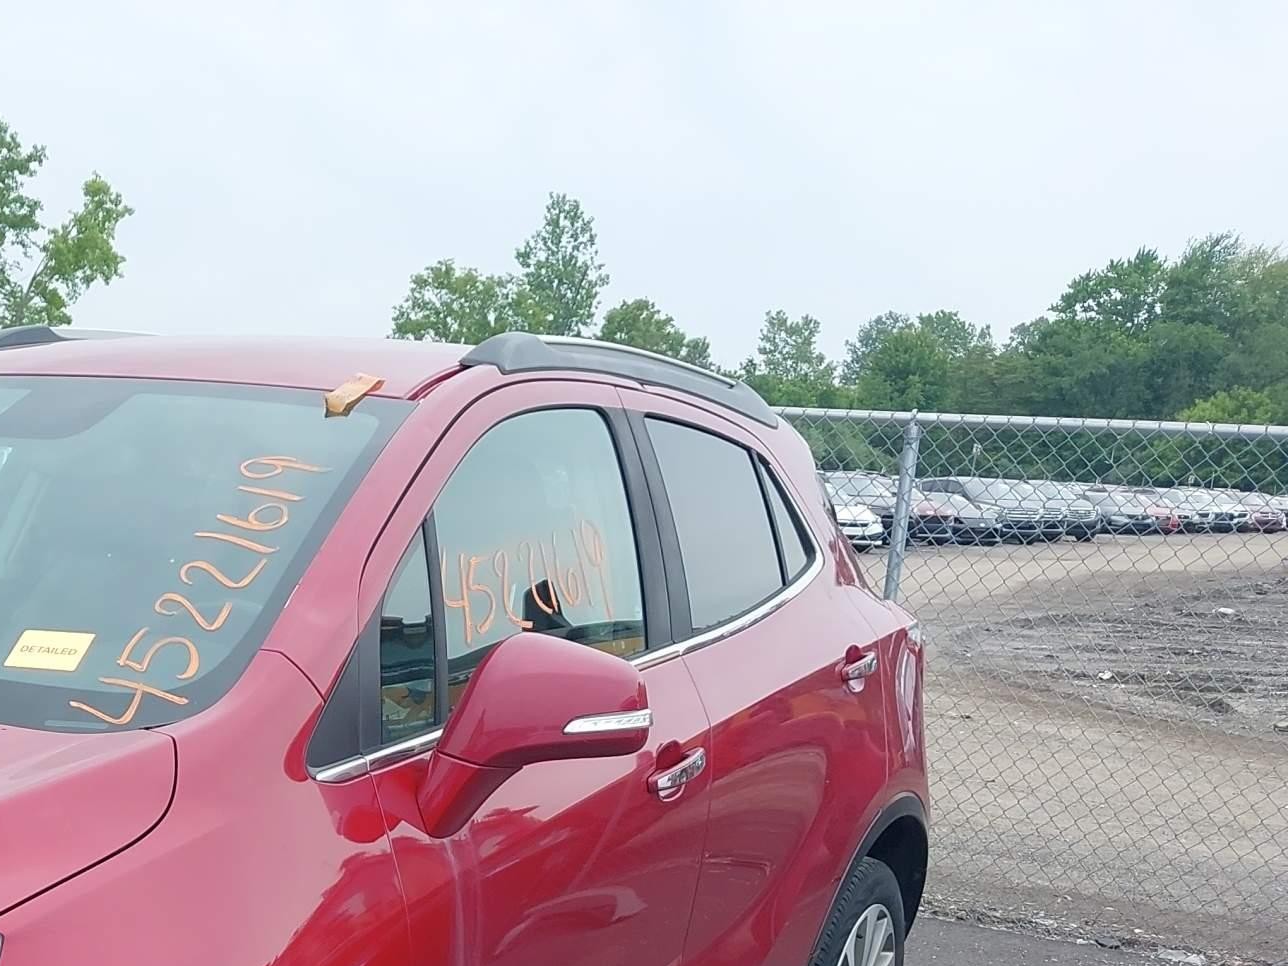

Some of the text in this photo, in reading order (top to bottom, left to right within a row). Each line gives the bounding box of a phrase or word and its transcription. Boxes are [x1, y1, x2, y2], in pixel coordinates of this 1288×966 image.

[69, 455, 333, 725] 45221619
[441, 518, 614, 649] 45221619
[19, 644, 79, 657] DETAILED
